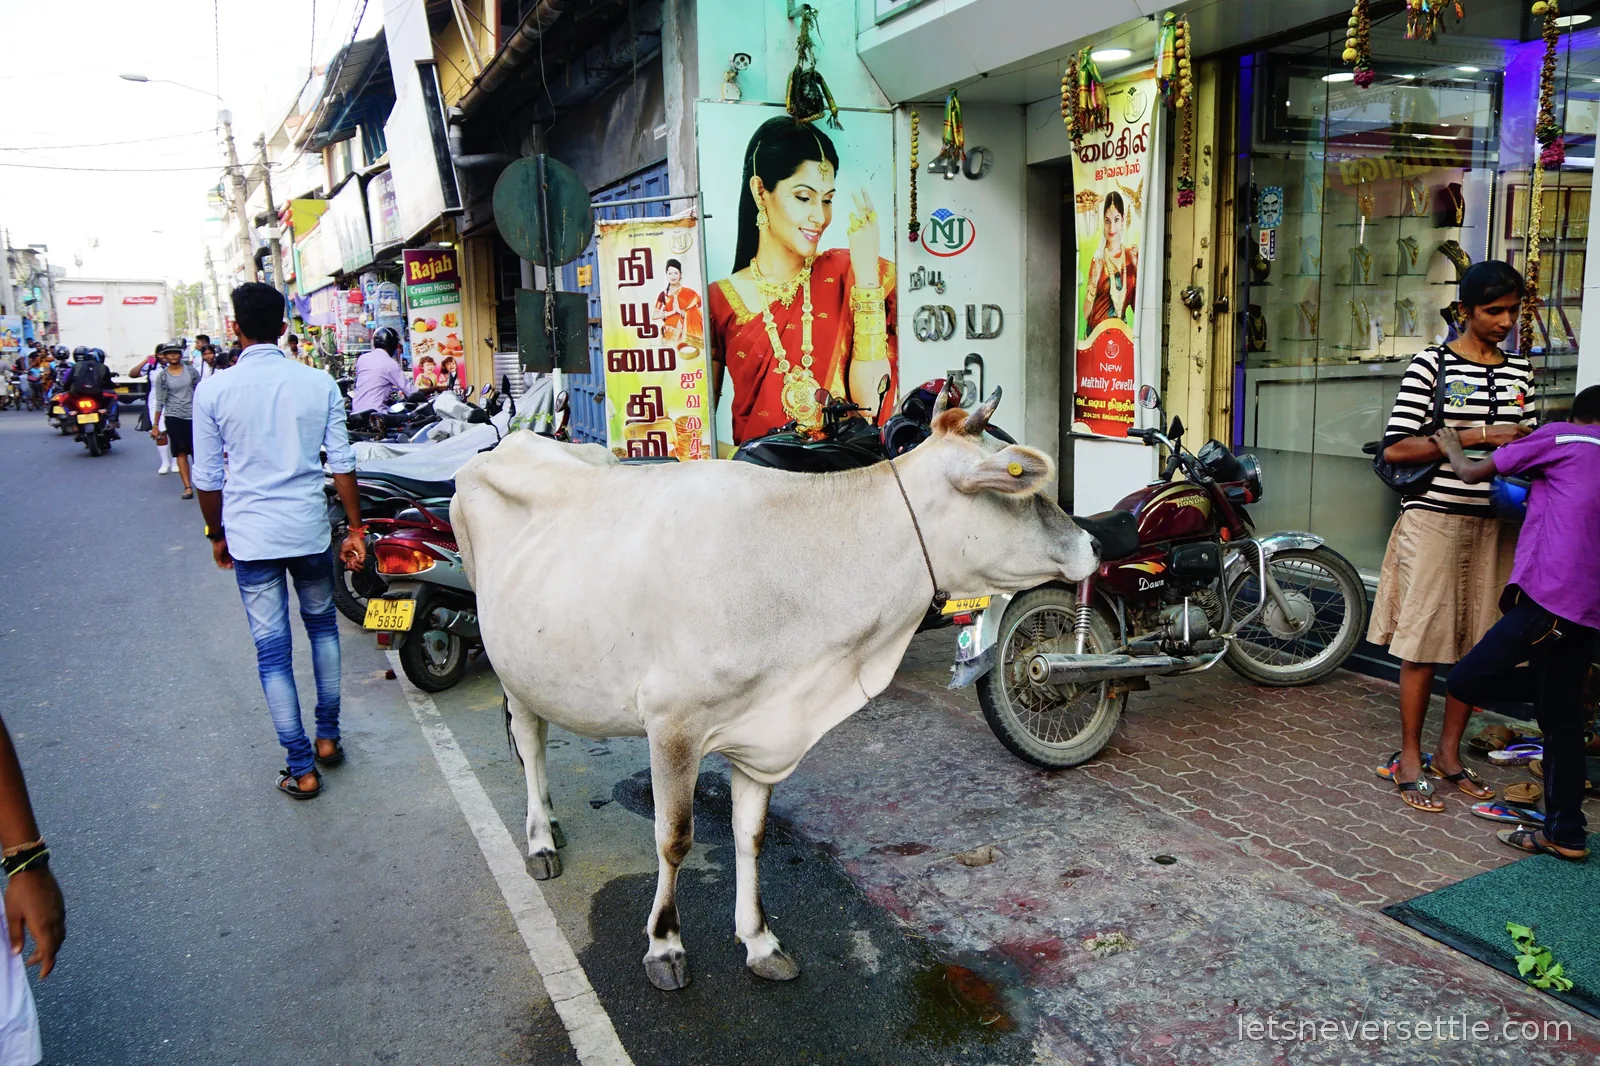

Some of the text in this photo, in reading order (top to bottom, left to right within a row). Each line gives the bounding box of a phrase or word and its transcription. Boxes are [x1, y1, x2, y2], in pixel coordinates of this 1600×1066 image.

[927, 146, 993, 181] 40
[410, 254, 453, 281] Rajah
[410, 282, 455, 295] Cream House
[412, 294, 459, 307] & Sweet Mart
[1099, 362, 1122, 372] New
[1081, 377, 1109, 392] Maithily
[1176, 497, 1205, 508] HONDA
[1138, 577, 1165, 591] Dawn
[377, 615, 403, 628] 5830
